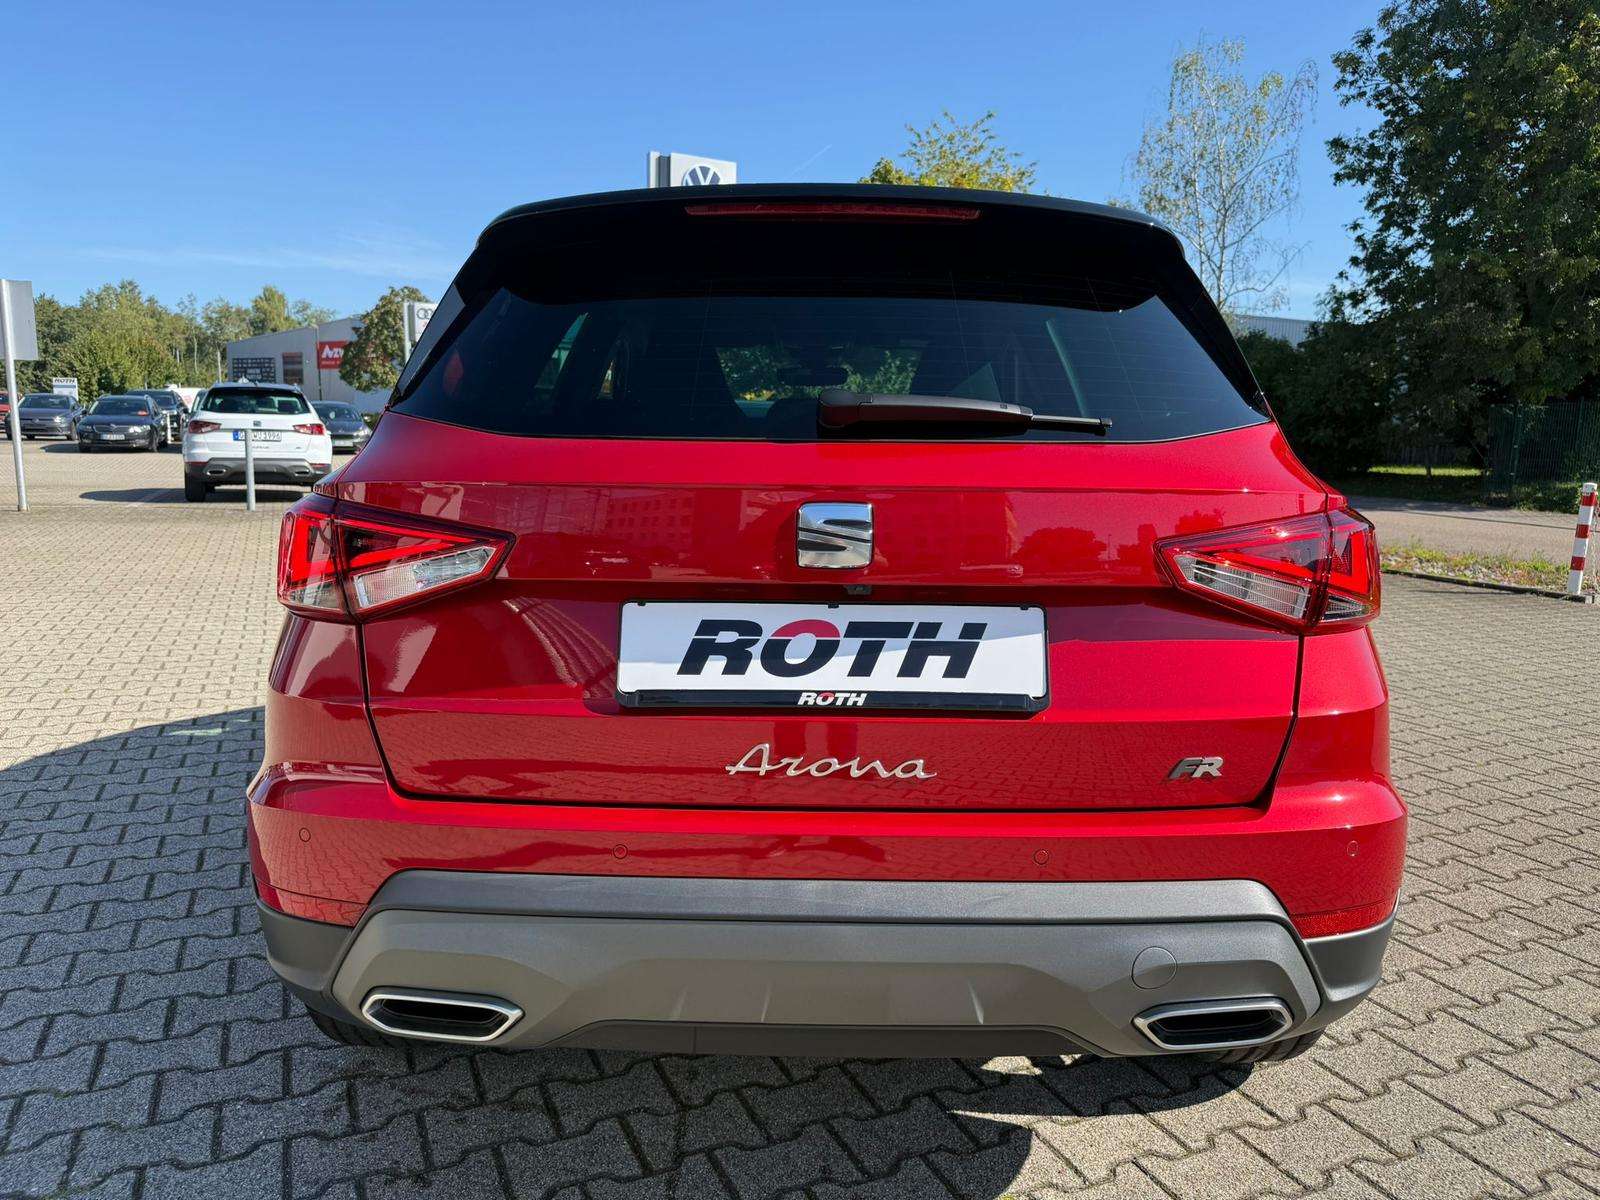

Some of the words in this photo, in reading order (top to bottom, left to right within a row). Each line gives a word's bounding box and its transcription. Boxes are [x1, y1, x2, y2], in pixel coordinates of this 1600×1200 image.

[677, 619, 988, 679] ROTH
[797, 691, 867, 706] ROTH
[725, 743, 938, 779] Arona
[1168, 756, 1223, 780] FR
